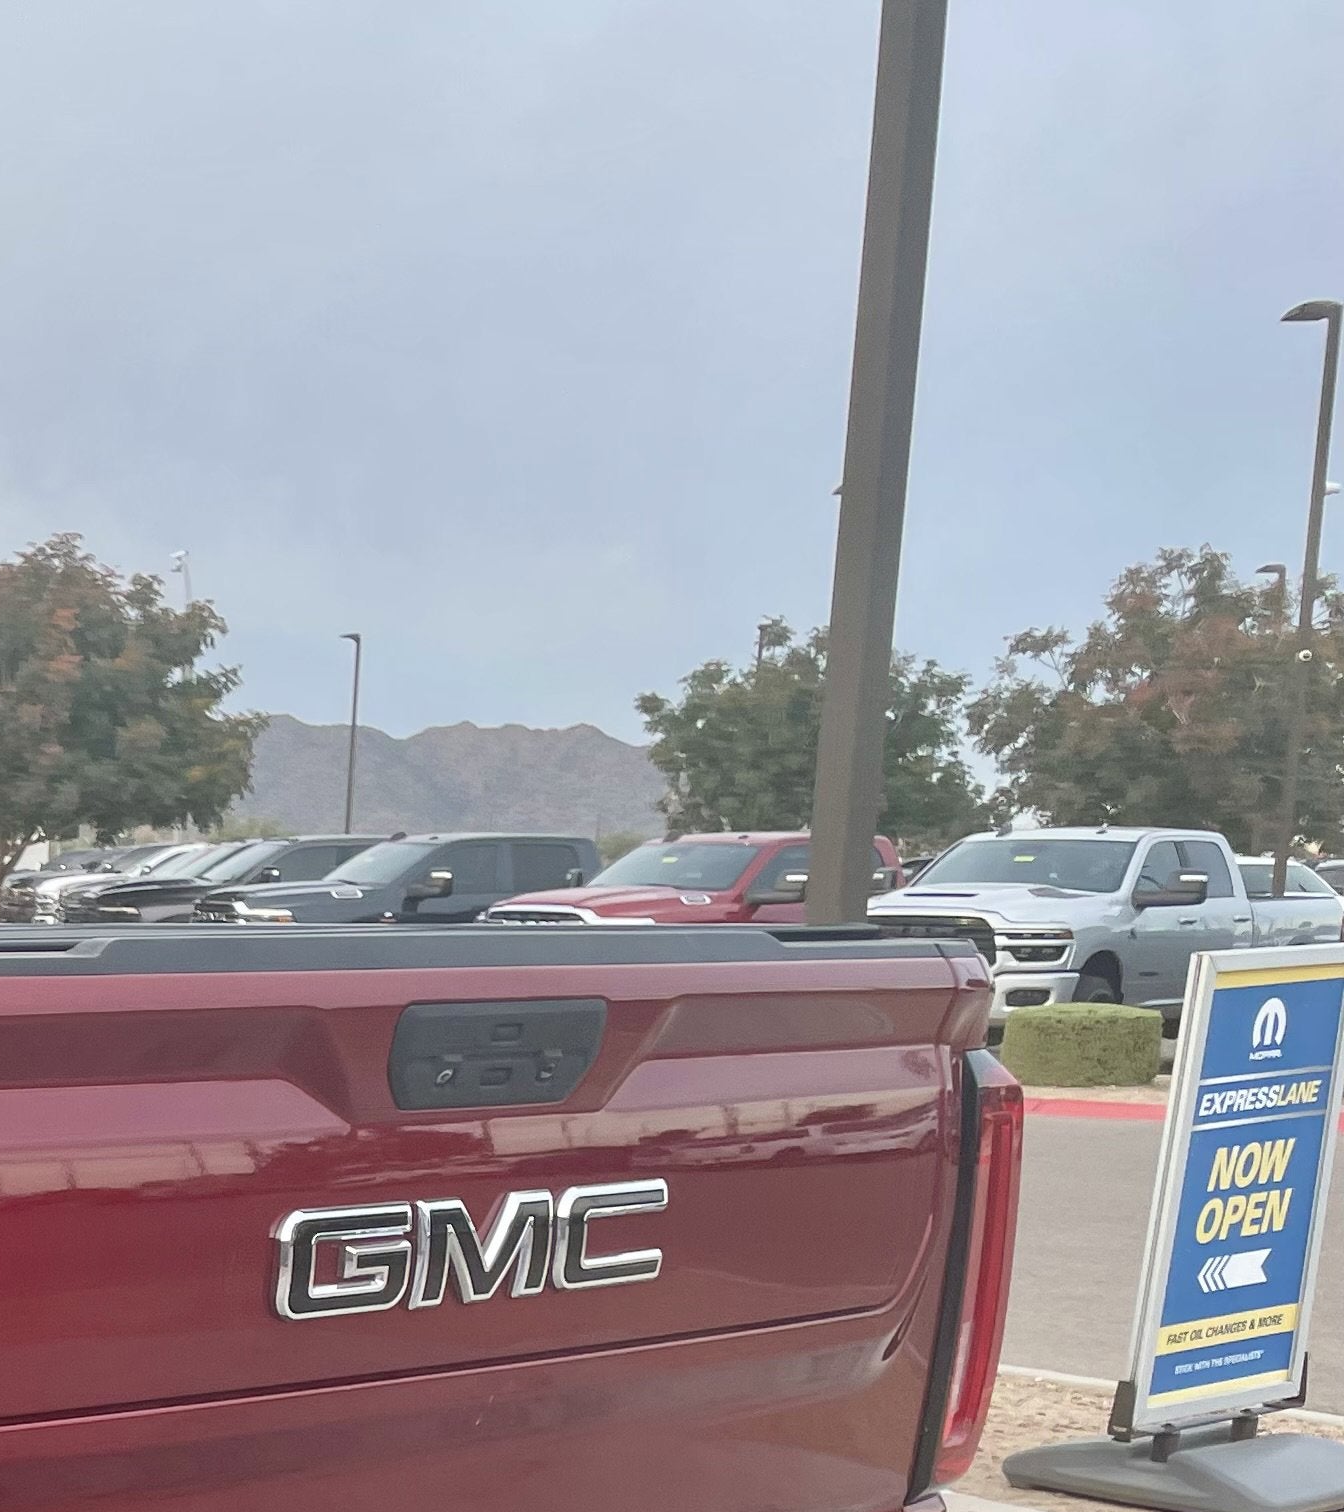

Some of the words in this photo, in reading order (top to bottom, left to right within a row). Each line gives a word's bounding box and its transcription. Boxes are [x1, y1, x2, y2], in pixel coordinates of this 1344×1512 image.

[1198, 1080, 1322, 1117] EXPRESSLANE
[1206, 1138, 1296, 1193] NOW
[1196, 1188, 1294, 1244] OPEN
[276, 1177, 668, 1320] GMC
[1167, 1331, 1188, 1345] FAST
[1190, 1328, 1203, 1341] OIL
[1205, 1319, 1247, 1338] CHANGES
[1248, 1318, 1255, 1330] &
[1257, 1314, 1283, 1328] MORE
